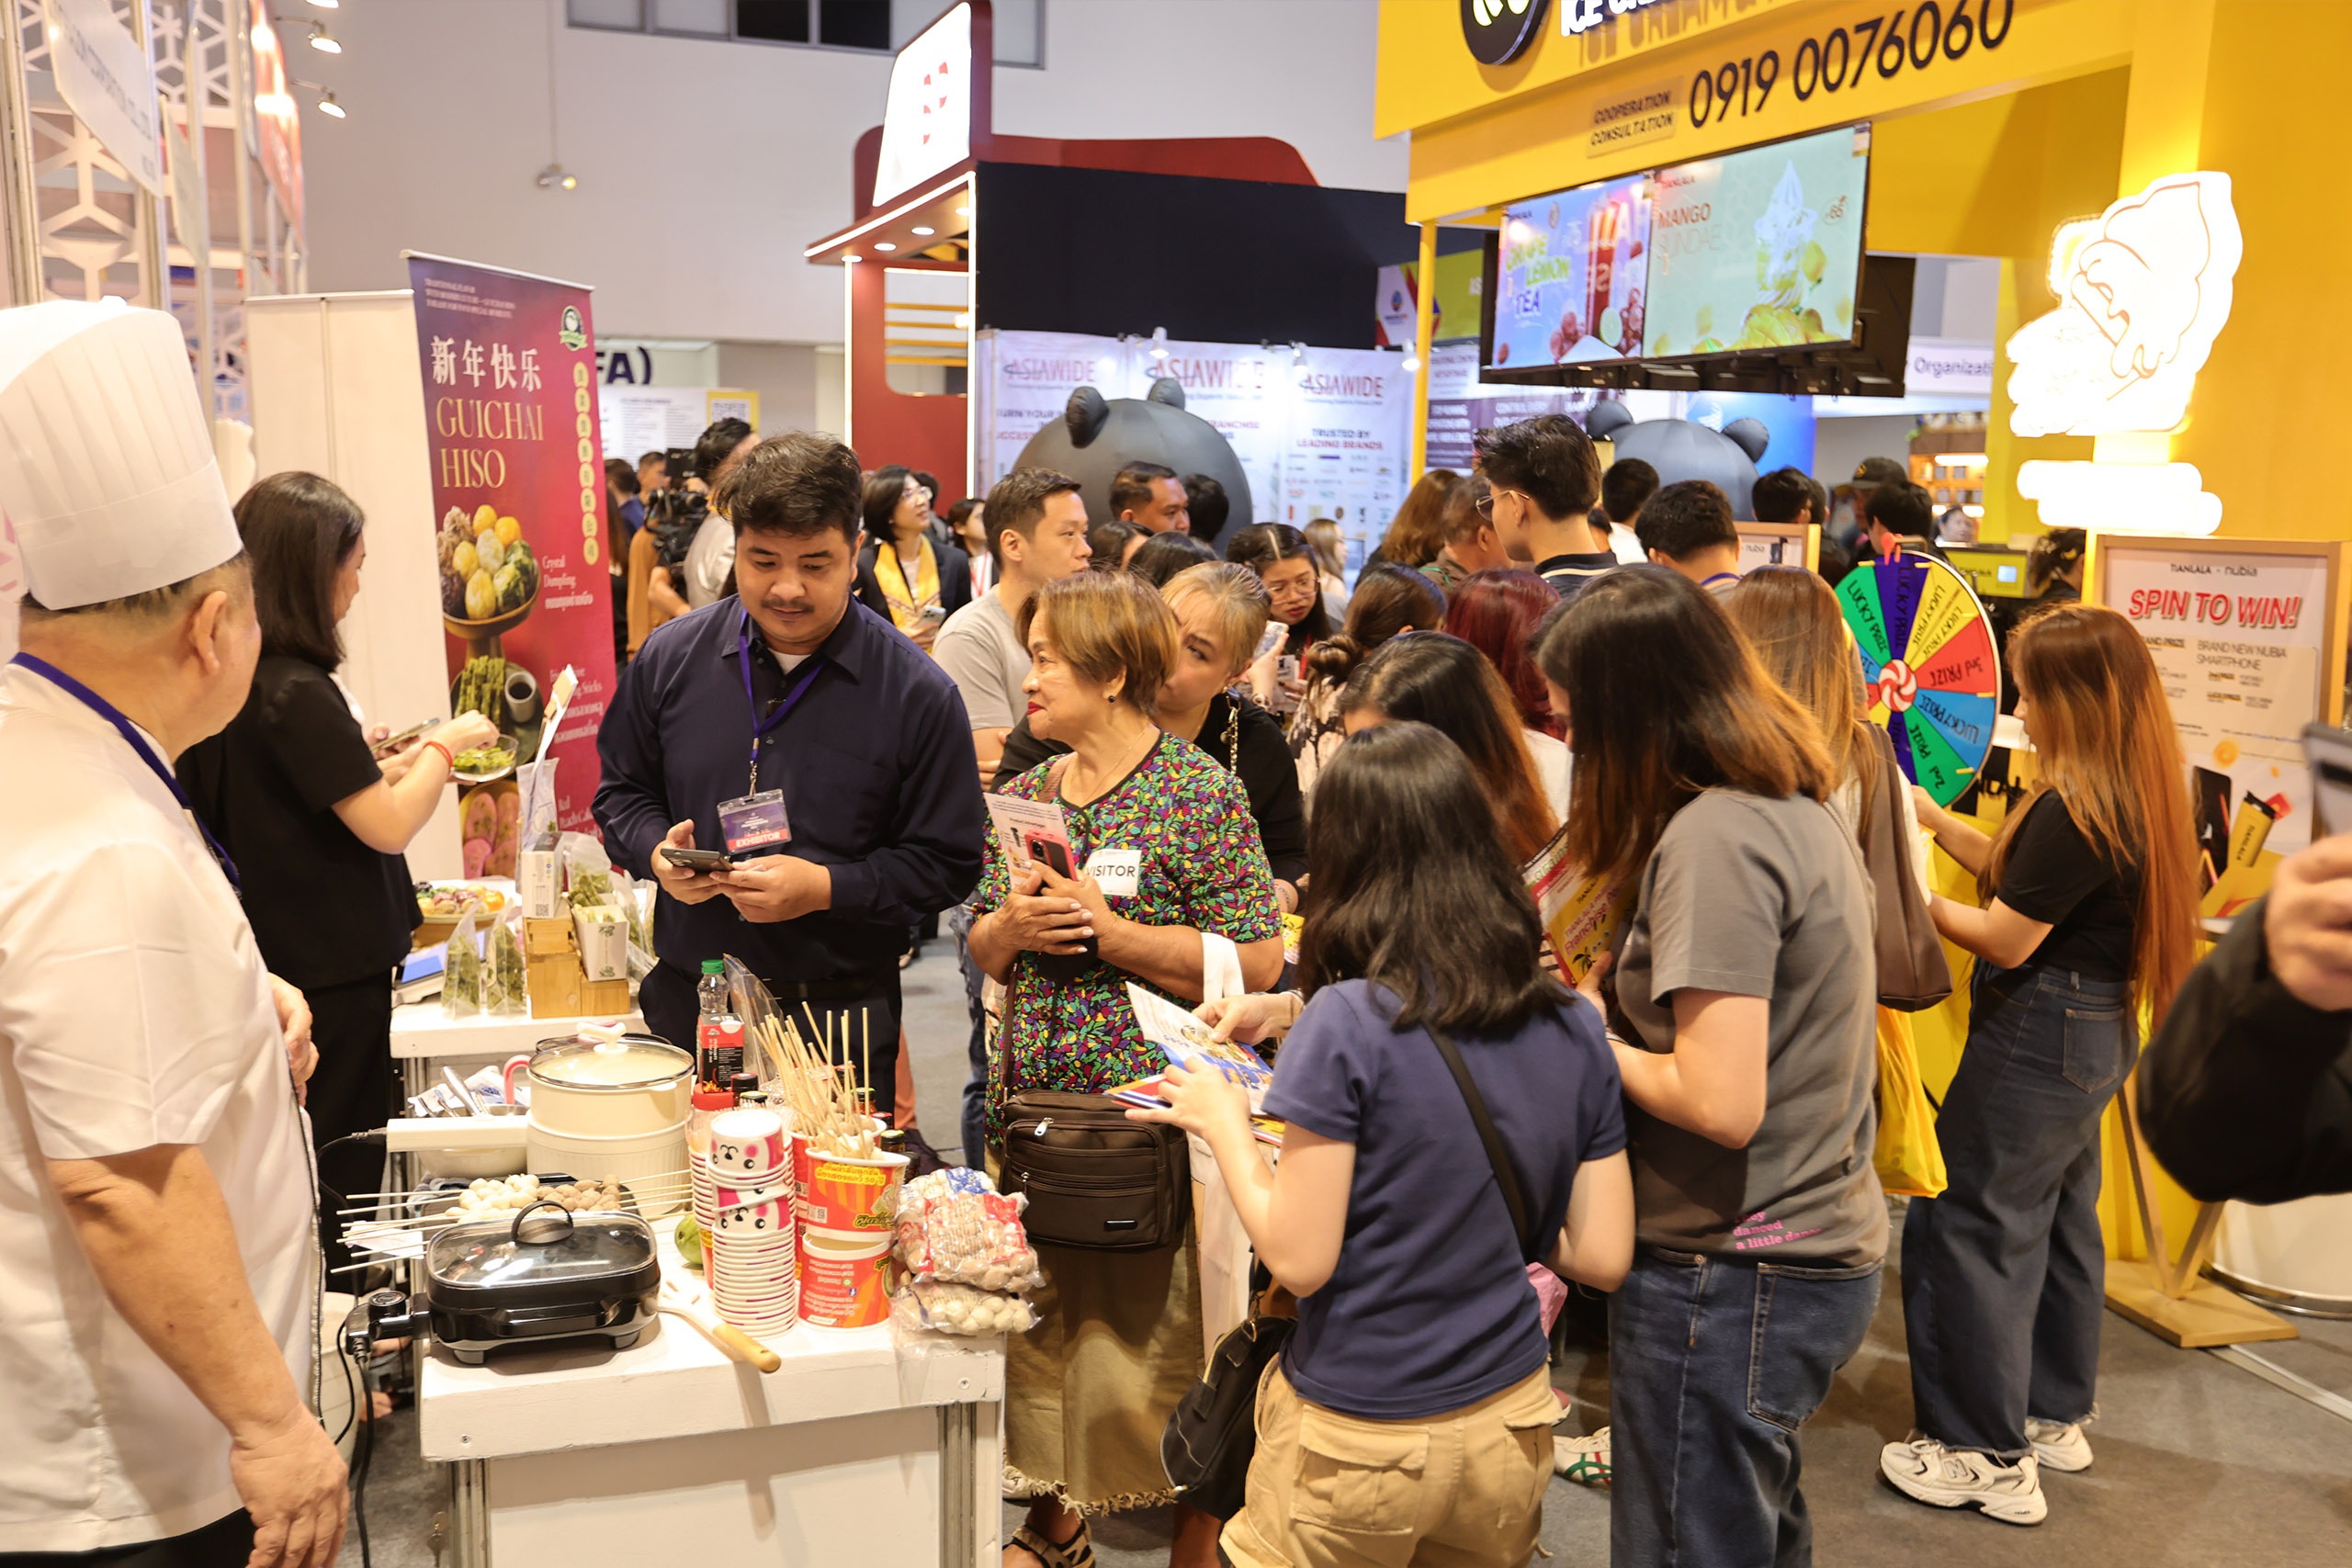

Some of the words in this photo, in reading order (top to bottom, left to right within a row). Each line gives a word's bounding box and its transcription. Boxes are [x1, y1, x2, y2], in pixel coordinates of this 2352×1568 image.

[1689, 51, 1780, 129] 0919
[1792, 0, 2013, 100] 0076060
[1593, 90, 1672, 125] COOPERATION
[1589, 113, 1674, 146] CONSULTATION
[1657, 201, 1713, 229] MANGO
[1525, 255, 1571, 288] LEMON
[1514, 290, 1542, 316] TEA
[430, 335, 542, 392] 新年快乐
[1003, 358, 1096, 384] ASIAWIDE
[1299, 374, 1384, 398] ASIAWIDE
[436, 396, 544, 441] GUICHAI
[1297, 439, 1340, 448] LEADING
[1342, 441, 1384, 451] BRANDS
[1312, 428, 1354, 439] TRUSTED
[1357, 430, 1370, 439] BY
[441, 447, 506, 489] HISO
[2171, 563, 2212, 575] TIANLALA
[2224, 566, 2257, 577] nubia
[1847, 580, 1875, 625] LUCKY
[1894, 566, 1913, 617] LUCKY
[1923, 584, 1946, 617] LUCKY
[1939, 605, 1962, 636] LUCKY
[2129, 589, 2188, 621] SPIN
[2196, 592, 2232, 624] TO
[2237, 596, 2302, 627] WIN!
[2197, 653, 2261, 671] SMARTPHONE
[2198, 639, 2230, 653] BRAND
[2232, 643, 2255, 656] NEW
[2256, 646, 2287, 659] NUBIA
[1929, 665, 1962, 687] PRIZE
[1966, 656, 1984, 678] 3rd
[1908, 723, 1931, 760] PRIZE
[1928, 765, 1946, 790] 2nd
[1087, 866, 1136, 877] VISITOR
[1734, 1220, 1782, 1236] danced
[1747, 1235, 1782, 1248] little
